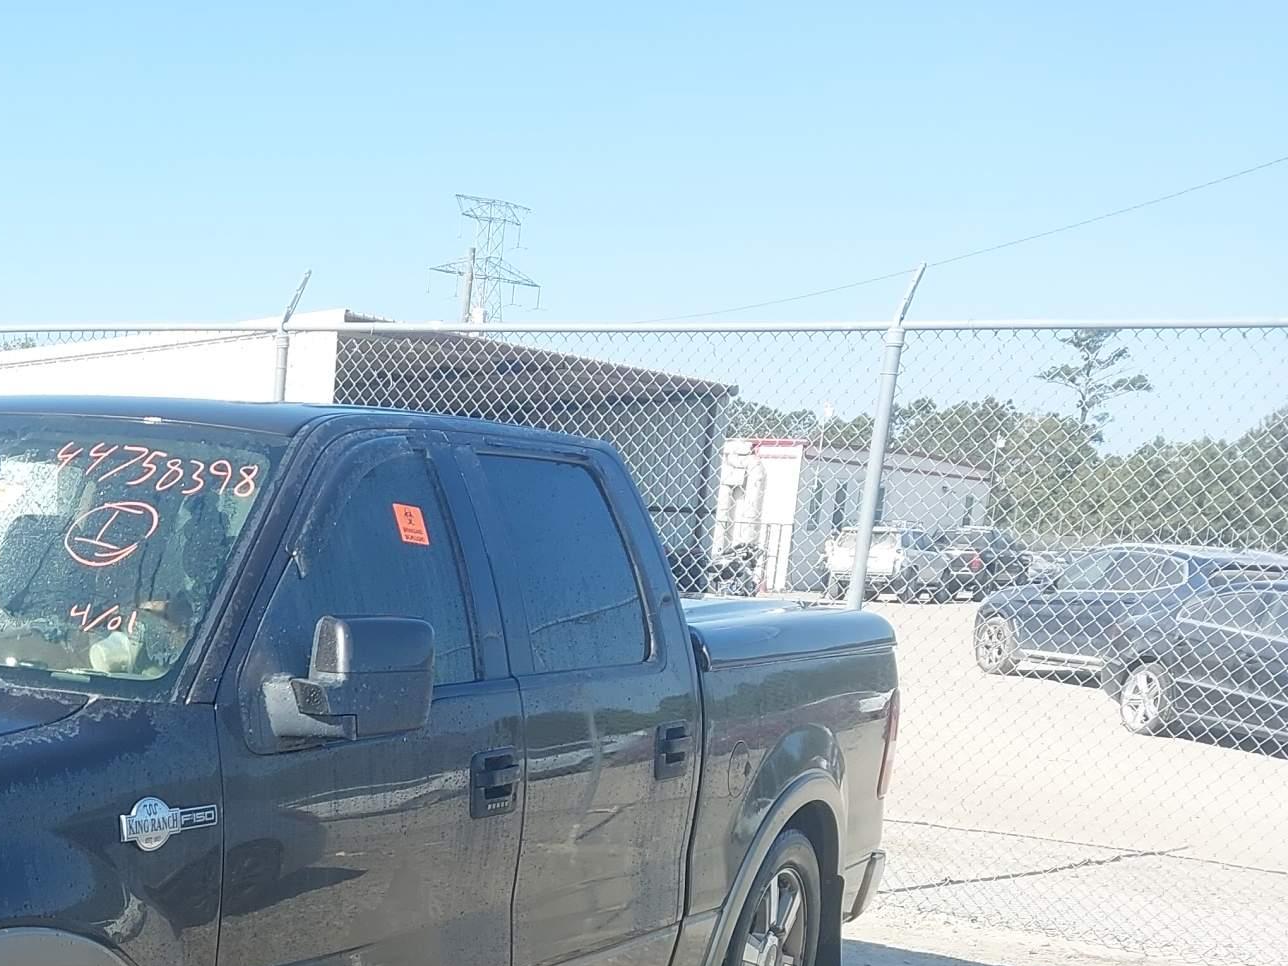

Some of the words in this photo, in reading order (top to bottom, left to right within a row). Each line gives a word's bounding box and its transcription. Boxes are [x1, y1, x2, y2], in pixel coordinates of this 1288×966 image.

[56, 441, 259, 497] 44758398
[70, 604, 137, 633] 4/01
[128, 817, 150, 835] KING
[150, 812, 178, 832] RANCH
